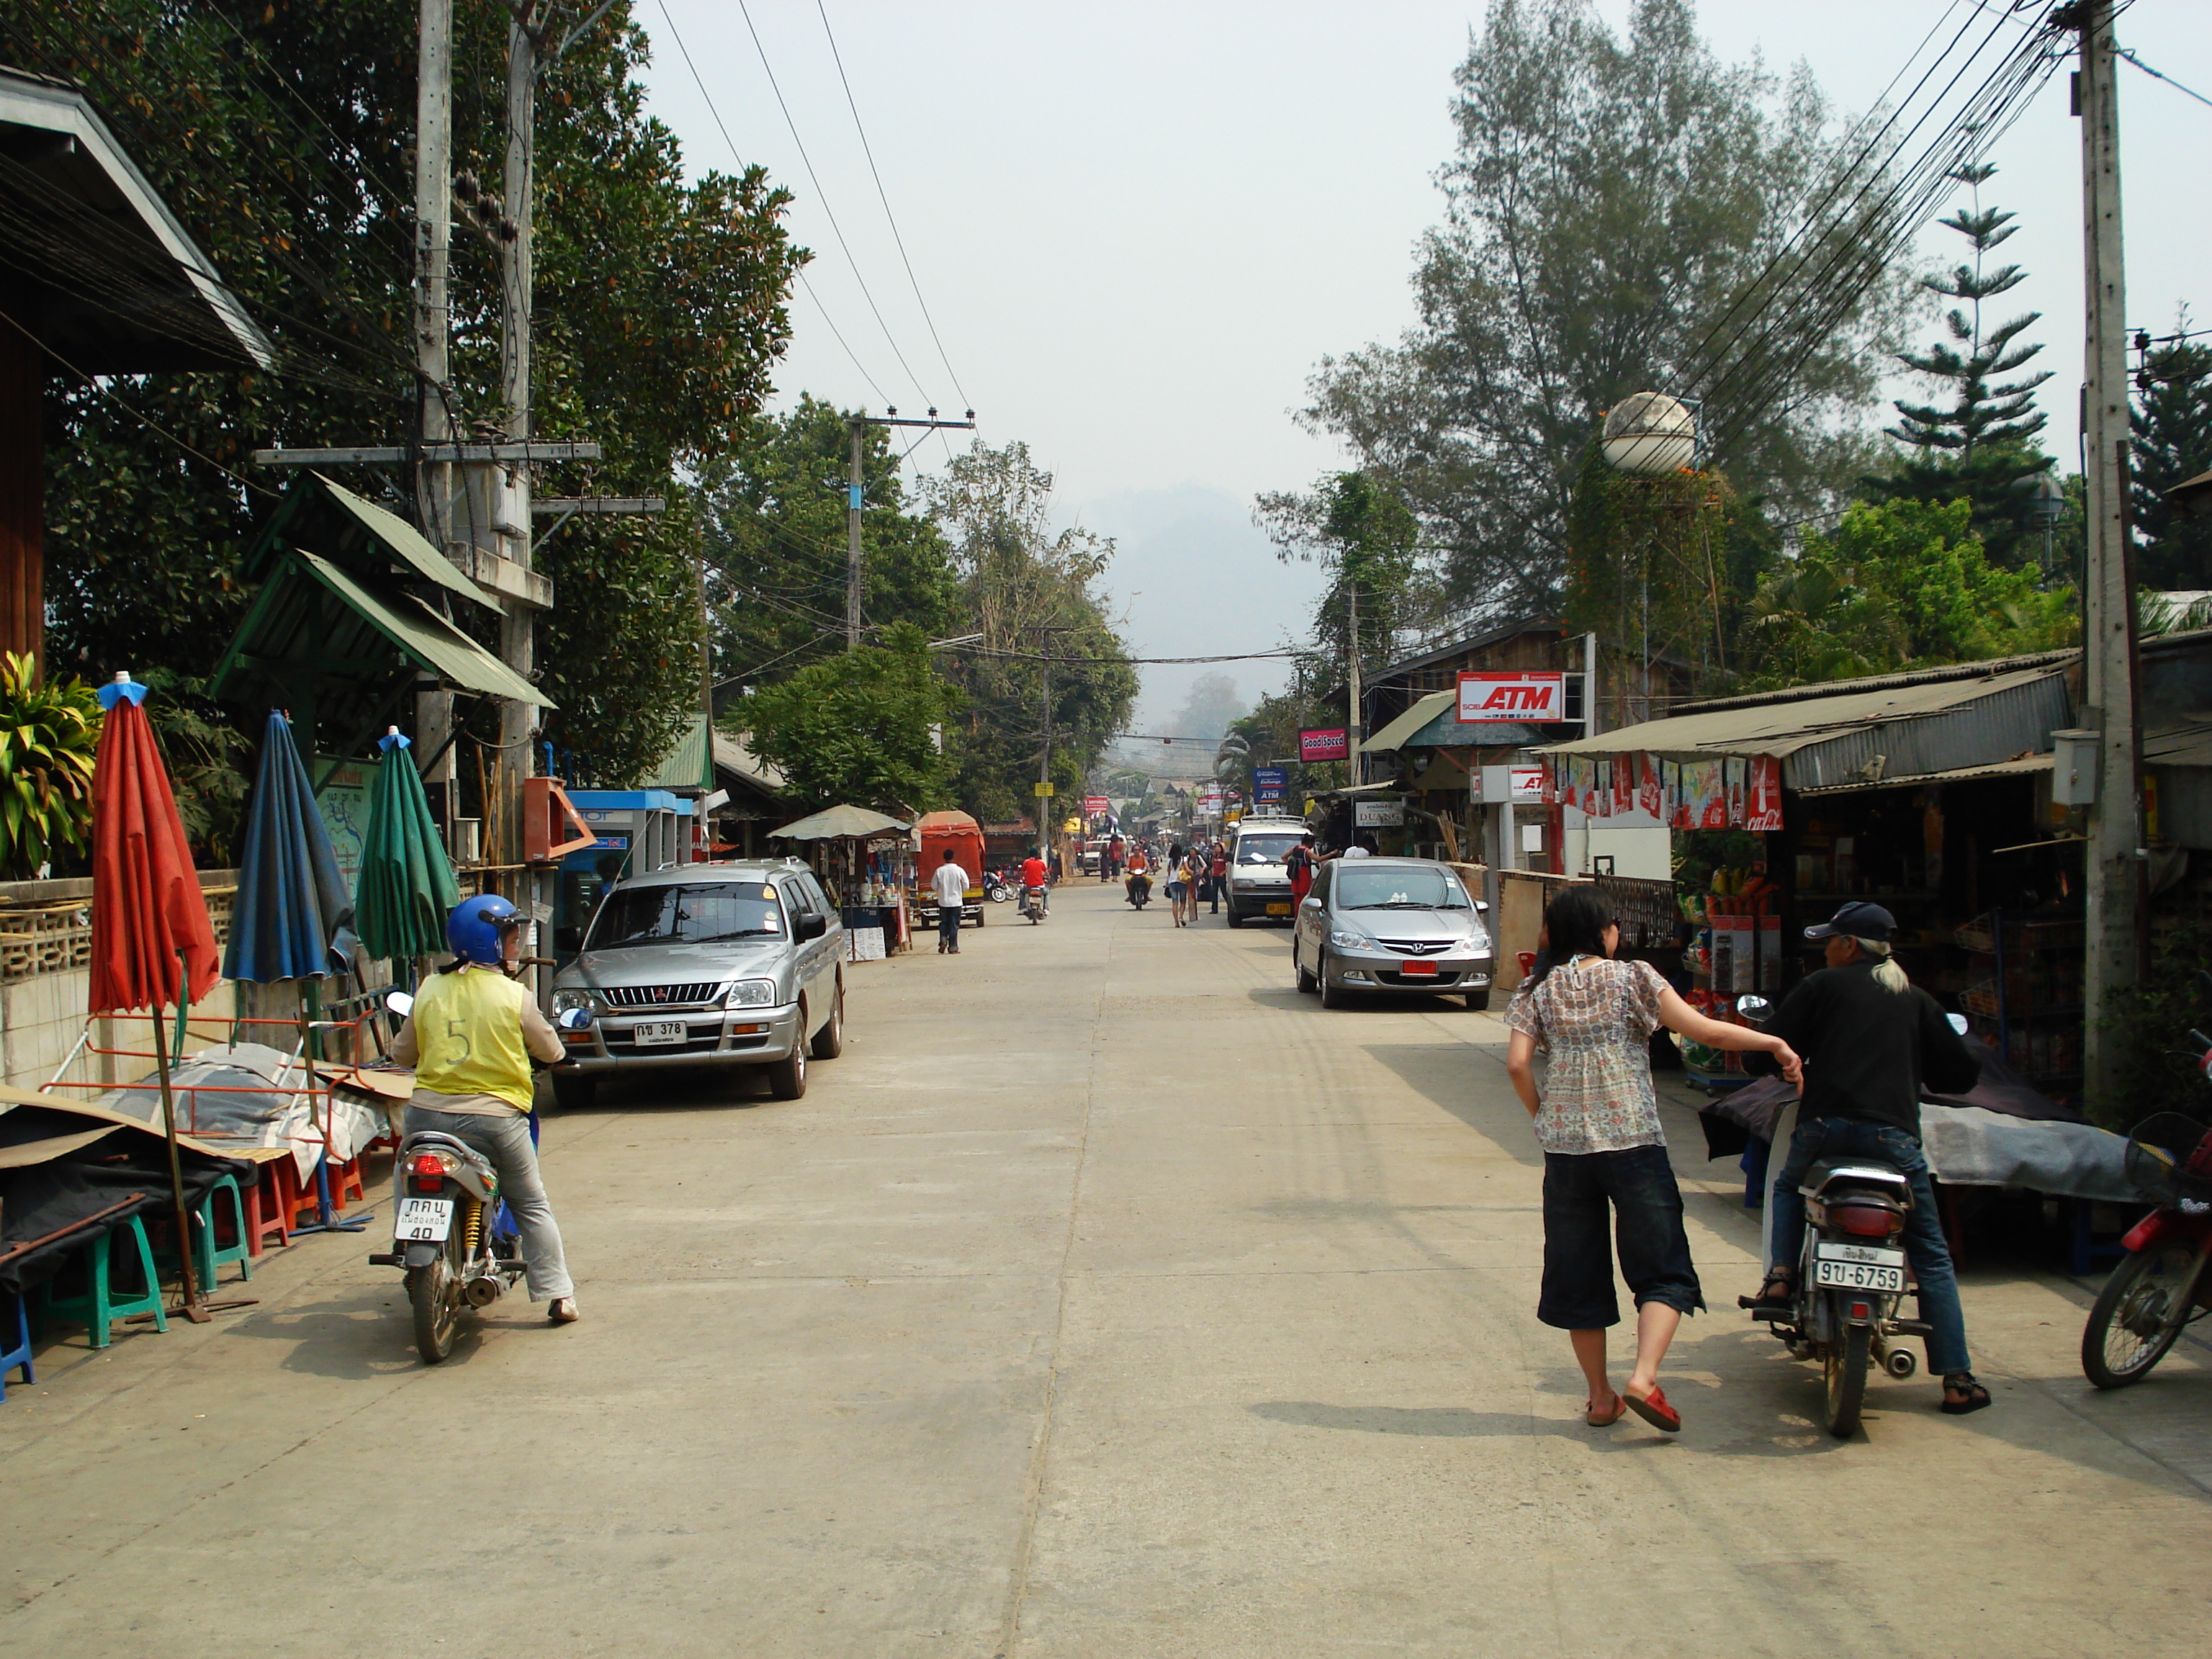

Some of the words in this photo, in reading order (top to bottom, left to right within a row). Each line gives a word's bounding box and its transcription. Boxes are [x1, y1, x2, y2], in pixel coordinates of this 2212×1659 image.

[1481, 686, 1552, 710] ATM
[1303, 736, 1322, 749] Good
[1323, 733, 1344, 750] Speed
[1360, 812, 1401, 821] DUANG
[637, 1025, 653, 1036] กข
[660, 1022, 681, 1035] 378
[446, 1018, 471, 1065] 5
[410, 1227, 433, 1239] 40
